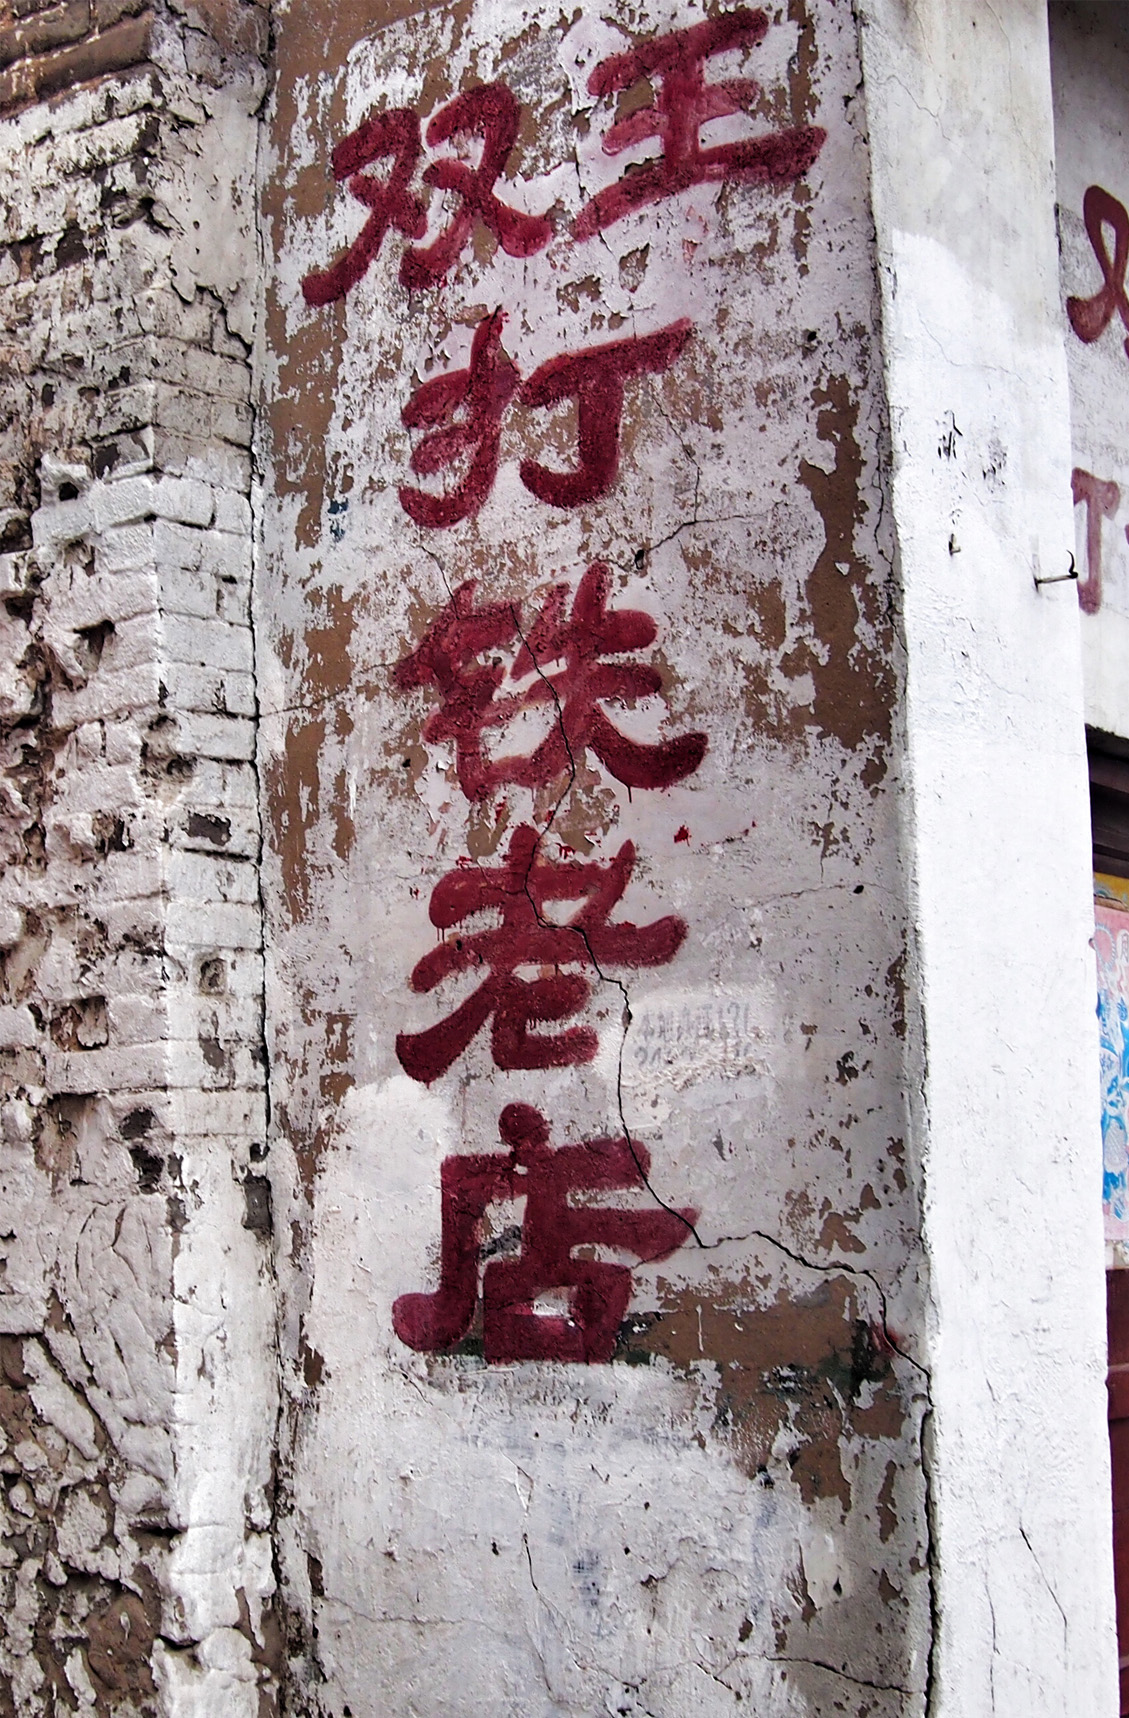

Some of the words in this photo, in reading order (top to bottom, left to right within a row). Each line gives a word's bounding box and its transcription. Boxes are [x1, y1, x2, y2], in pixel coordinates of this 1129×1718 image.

[302, 9, 827, 302] 双王
[391, 305, 709, 1364] 打铁老店
